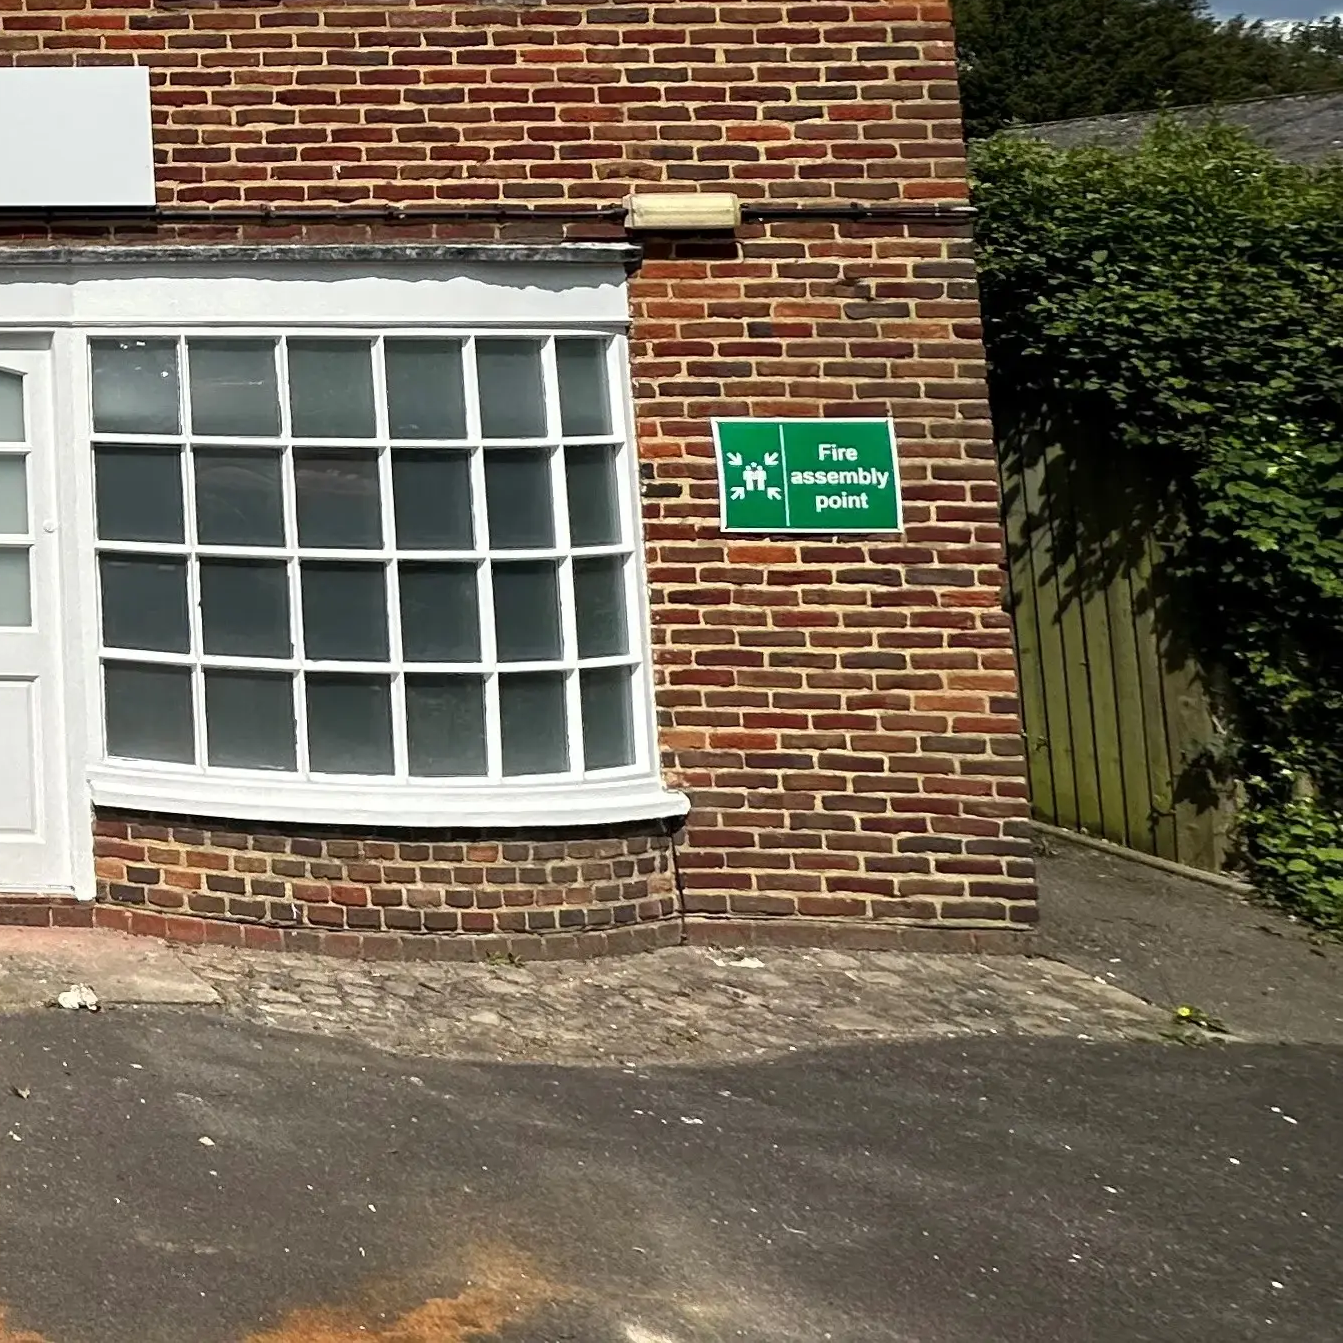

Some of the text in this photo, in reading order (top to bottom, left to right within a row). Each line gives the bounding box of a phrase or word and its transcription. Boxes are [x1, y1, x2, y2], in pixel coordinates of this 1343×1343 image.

[818, 443, 858, 462] Fire
[790, 467, 889, 489] assembly
[815, 492, 869, 512] point
